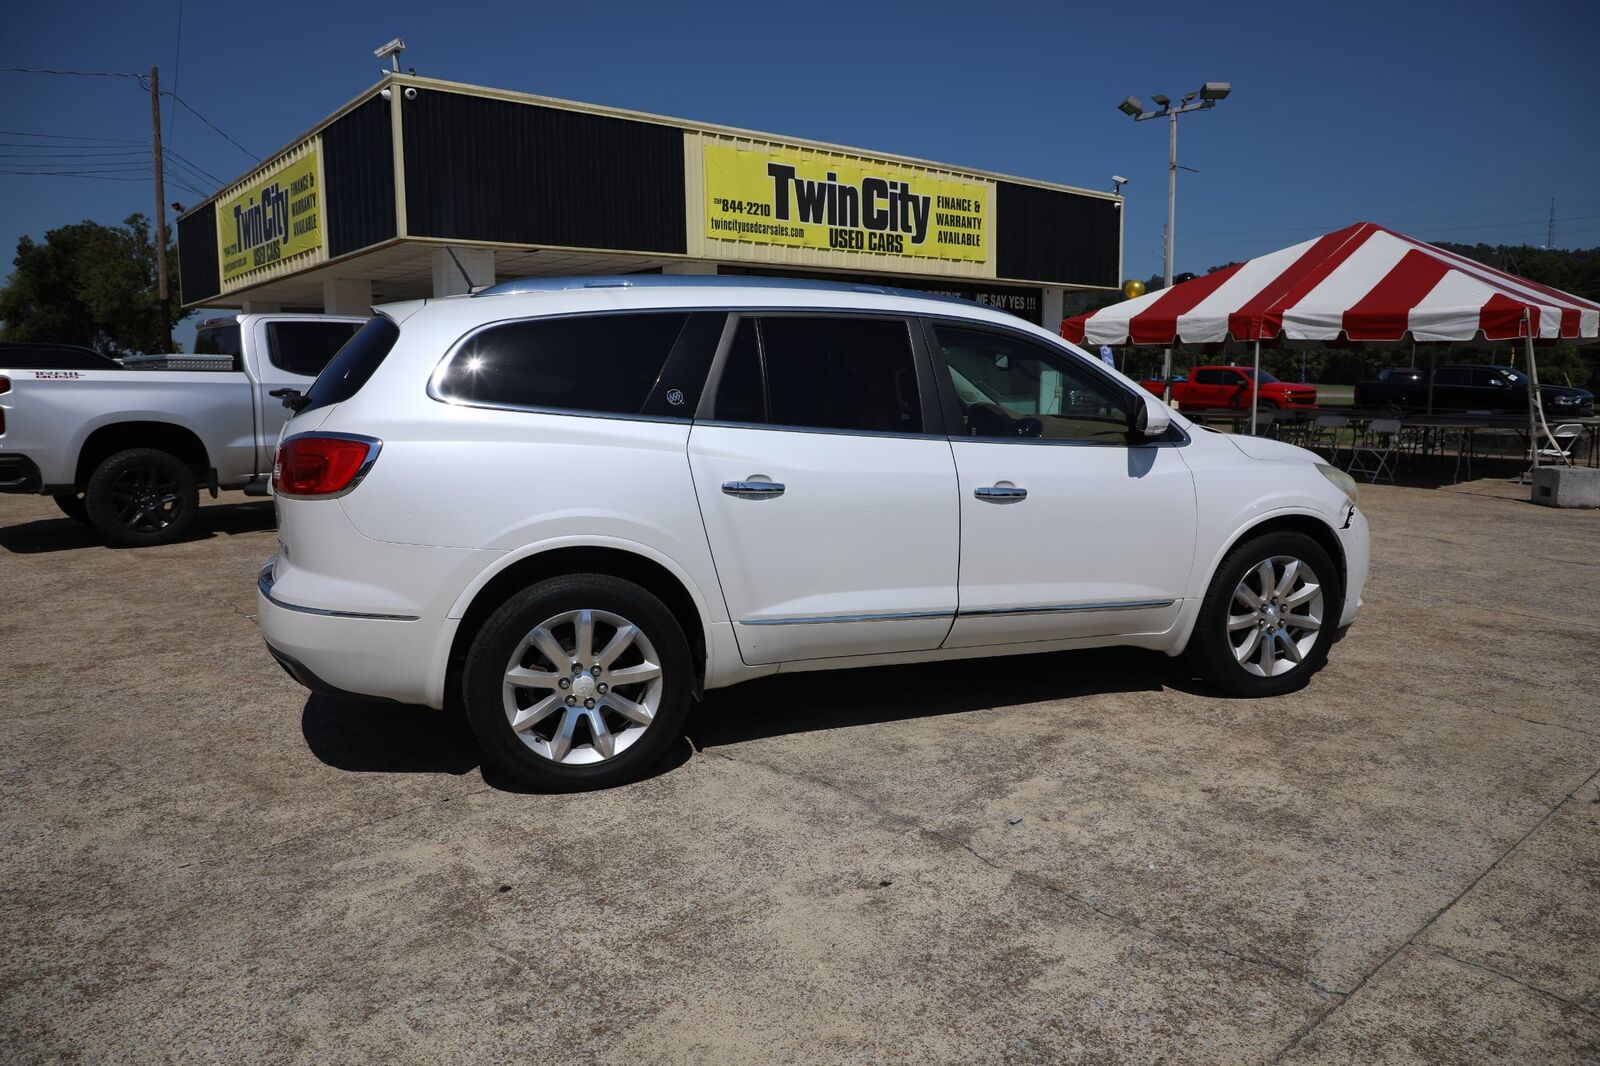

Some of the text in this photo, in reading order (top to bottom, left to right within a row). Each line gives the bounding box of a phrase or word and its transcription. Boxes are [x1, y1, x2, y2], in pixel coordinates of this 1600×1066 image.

[936, 195, 981, 213] FINANCE &
[711, 217, 805, 238] twincityusedcarsales.com
[936, 213, 982, 230] WARRANTY
[829, 228, 903, 253] USED CARS
[937, 230, 981, 247] AVAILABLE
[990, 294, 1007, 309] SAY
[1008, 296, 1025, 310] YES
